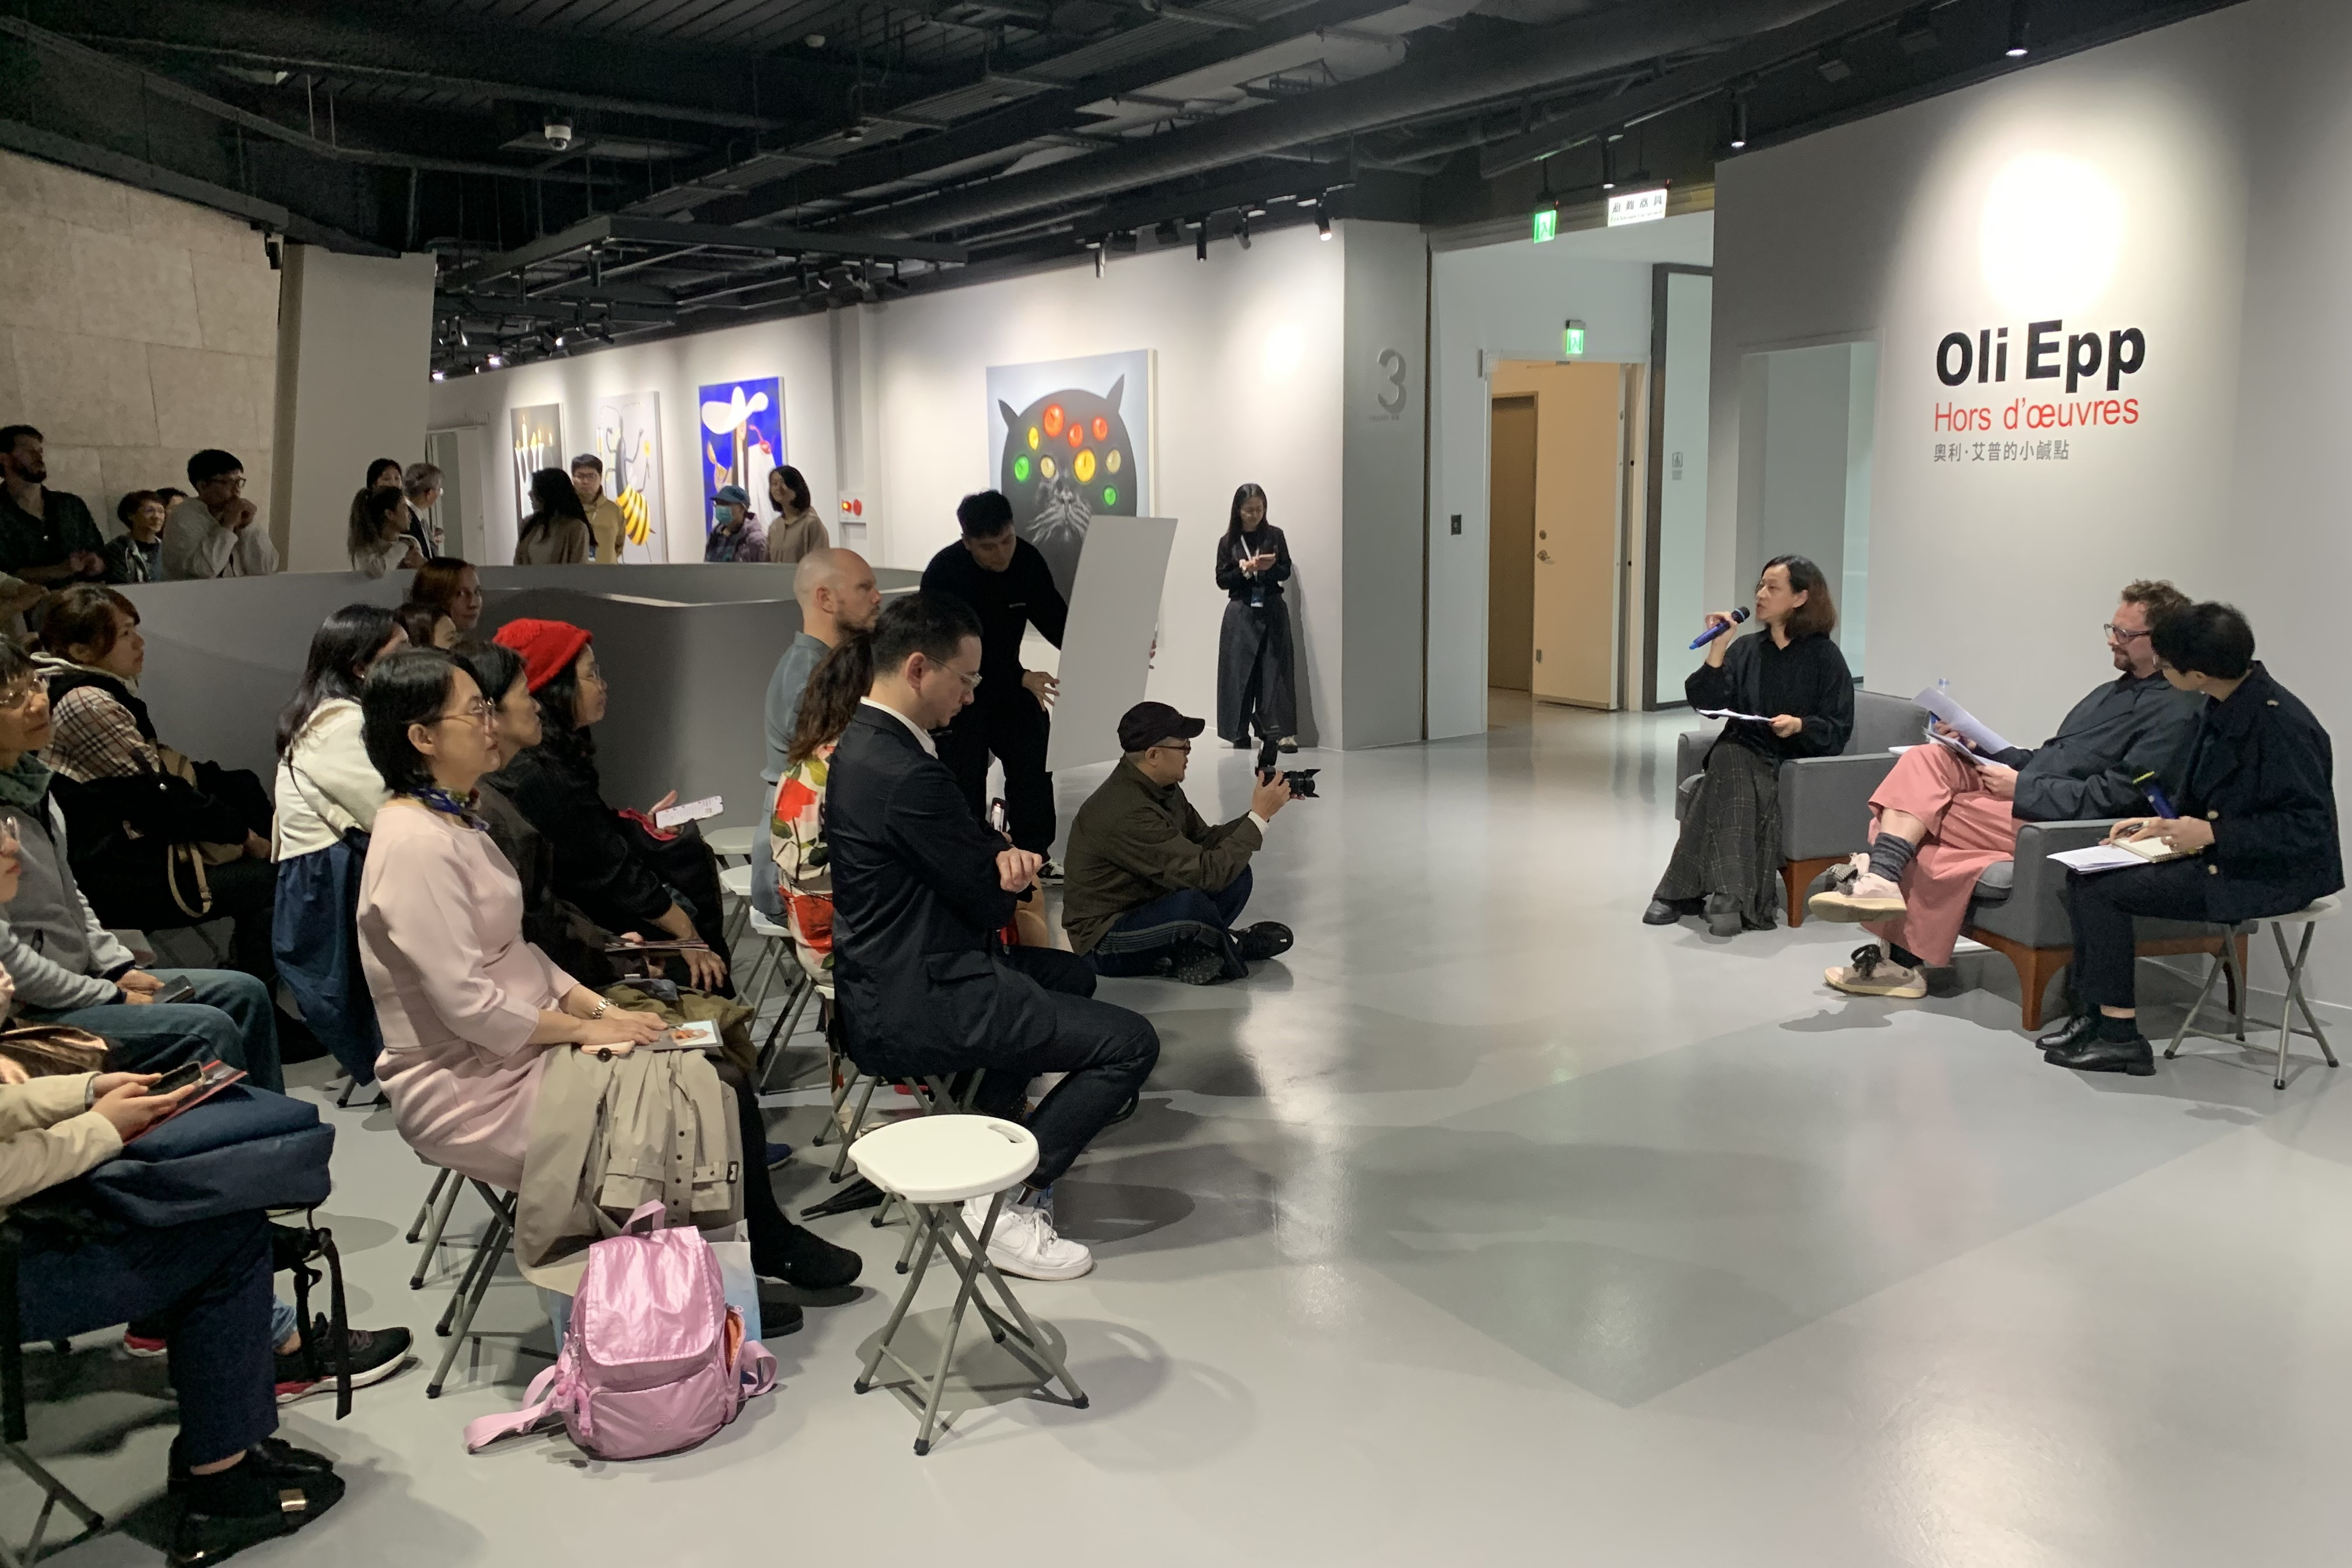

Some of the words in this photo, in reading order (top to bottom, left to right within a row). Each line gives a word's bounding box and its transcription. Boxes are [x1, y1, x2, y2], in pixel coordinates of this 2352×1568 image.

[1377, 347, 1406, 414] 3
[1936, 327, 2008, 387] Oli
[2025, 319, 2146, 394] Epp
[1934, 402, 1992, 432] Hors
